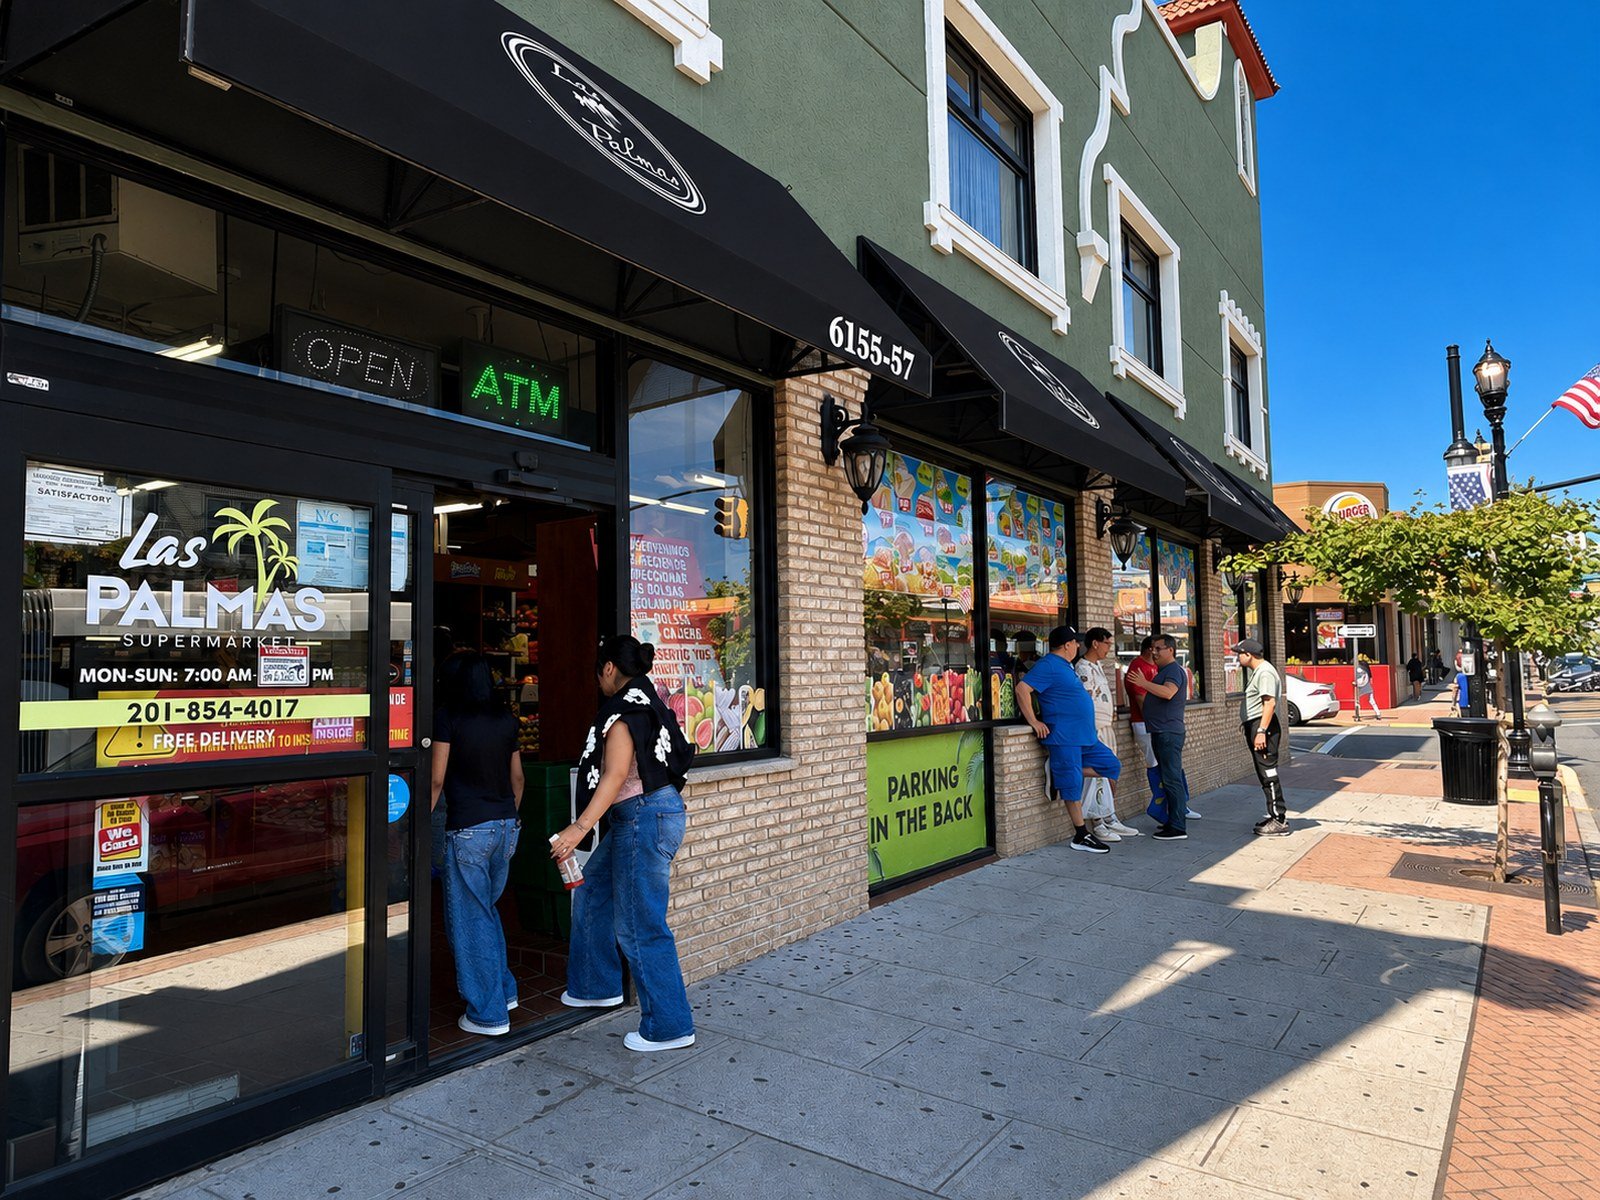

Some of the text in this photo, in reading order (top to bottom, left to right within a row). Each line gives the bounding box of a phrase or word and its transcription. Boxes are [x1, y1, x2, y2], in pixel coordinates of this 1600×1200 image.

[551, 62, 600, 101] Las
[582, 117, 680, 186] Palmas
[307, 338, 415, 390] OPEN
[829, 316, 915, 380] 6155-57
[471, 364, 560, 419] ATM
[37, 487, 112, 503] SATISFACTORY
[1339, 504, 1369, 519] URGER
[118, 512, 207, 570] Las
[86, 574, 326, 632] PALMAS
[123, 633, 295, 648] SUPERMARKET
[79, 668, 178, 683] MON-SUN:
[184, 668, 222, 682] 7:00
[312, 668, 334, 681] PM
[127, 699, 299, 723] 201-854-4017
[153, 732, 195, 749] FREE
[200, 729, 276, 747] DELIVERY
[888, 765, 959, 803] PARKING
[107, 827, 132, 840] We
[870, 794, 973, 844] IN THE BACK
[101, 835, 139, 852] Card
